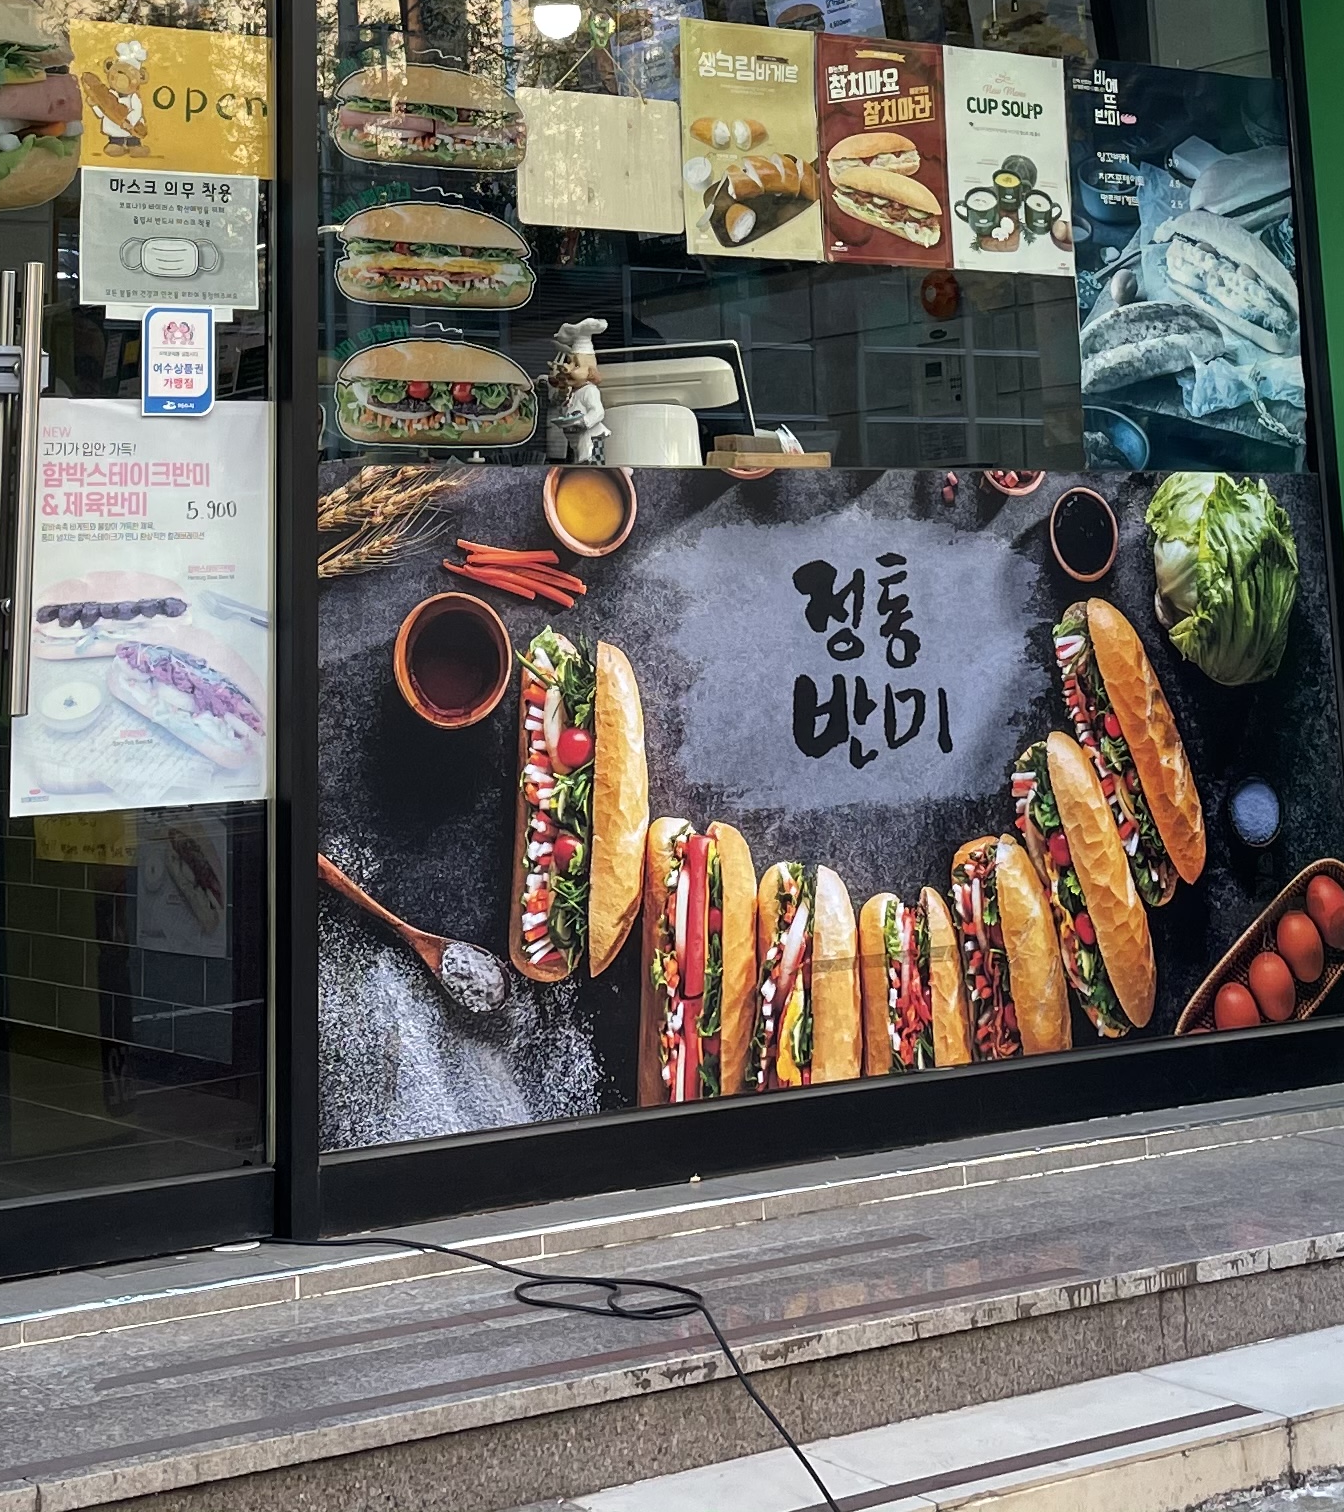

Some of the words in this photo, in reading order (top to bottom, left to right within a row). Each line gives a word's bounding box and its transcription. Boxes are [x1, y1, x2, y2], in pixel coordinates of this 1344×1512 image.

[828, 68, 900, 99] 참치마요
[152, 85, 267, 123] open
[863, 97, 932, 127] 참치마라
[966, 96, 998, 114] CUP
[1001, 100, 1043, 119] SOUP
[109, 178, 157, 194] 마스크
[164, 181, 195, 199] 의무
[202, 181, 232, 203] 착용
[153, 363, 204, 375] 여수상품권
[163, 378, 194, 389] 가맹점
[42, 426, 72, 438] NEW
[43, 442, 79, 456] 고기가
[82, 442, 105, 456] 입안
[109, 443, 136, 456] 가득!
[42, 461, 210, 488] 함박스테이크반미
[792, 552, 921, 669] 정통
[792, 673, 953, 769] 반미
